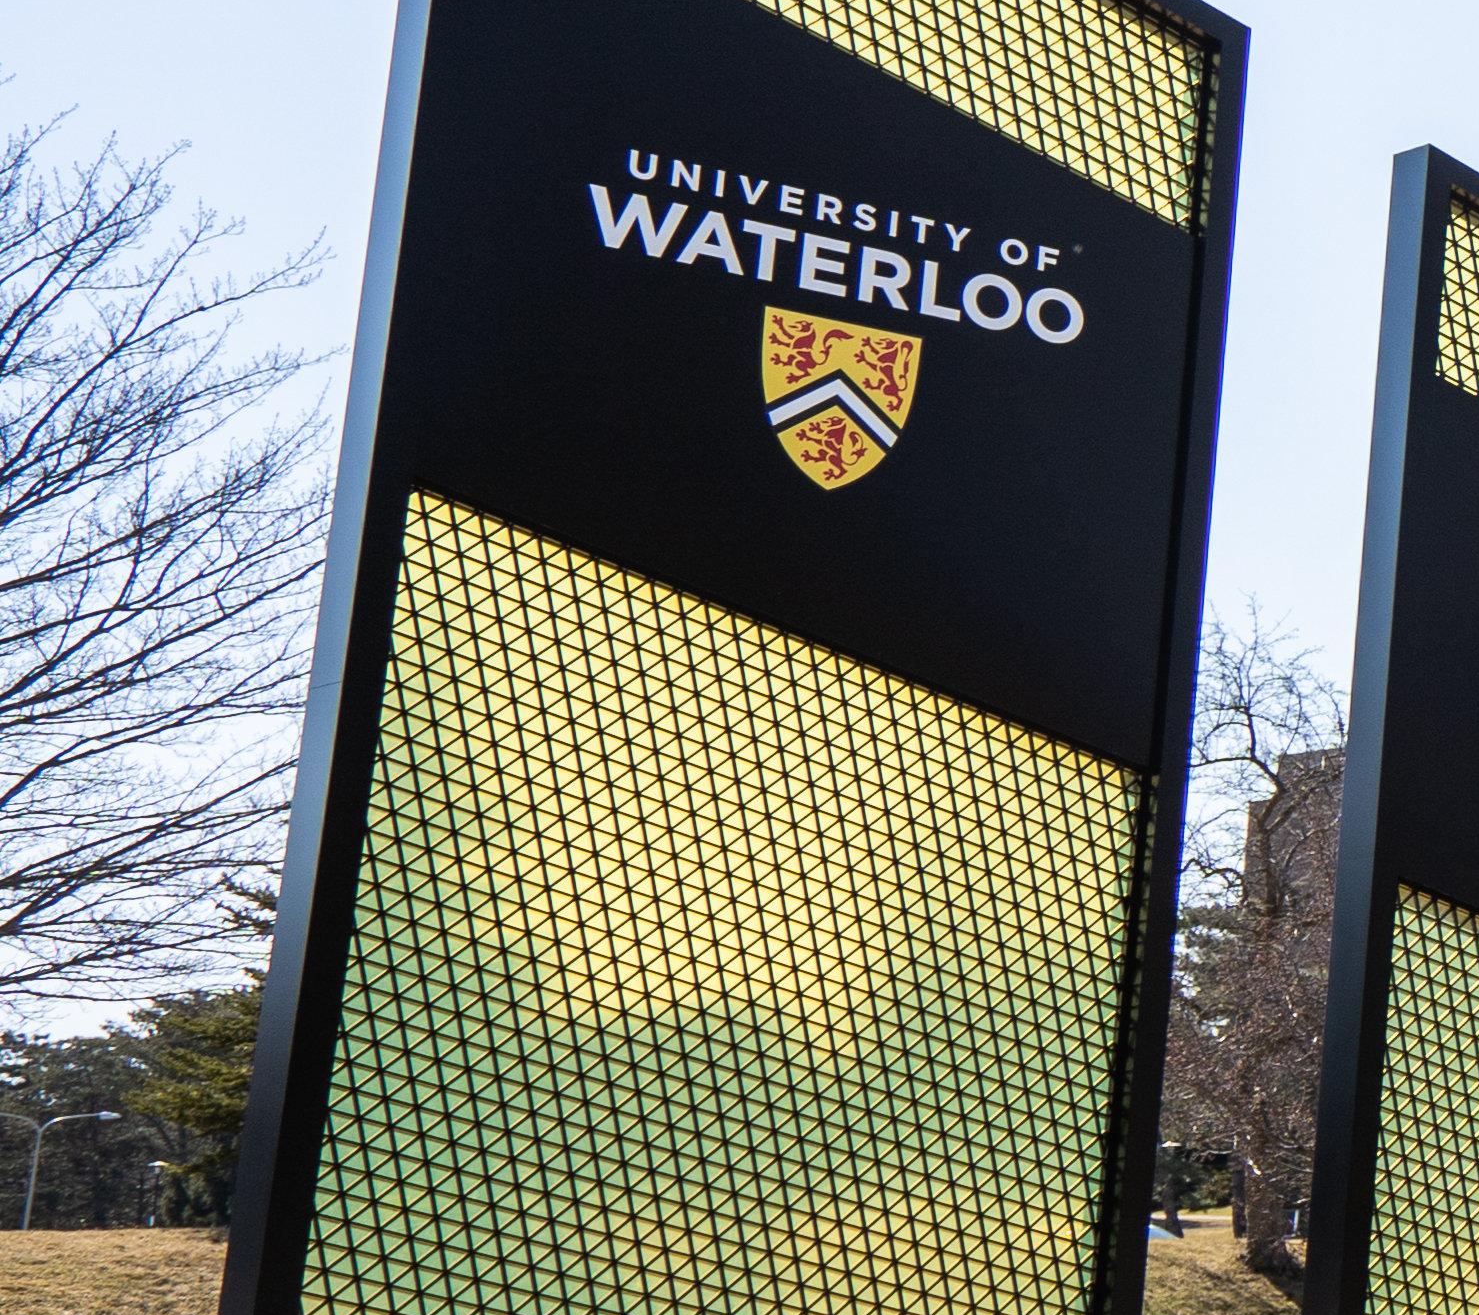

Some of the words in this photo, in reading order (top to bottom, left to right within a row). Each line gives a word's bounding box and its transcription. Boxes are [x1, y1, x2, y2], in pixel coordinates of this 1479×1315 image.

[589, 183, 1084, 344] WATERLOO
[629, 149, 971, 252] UNIVERSITY
[1001, 238, 1060, 272] OF
